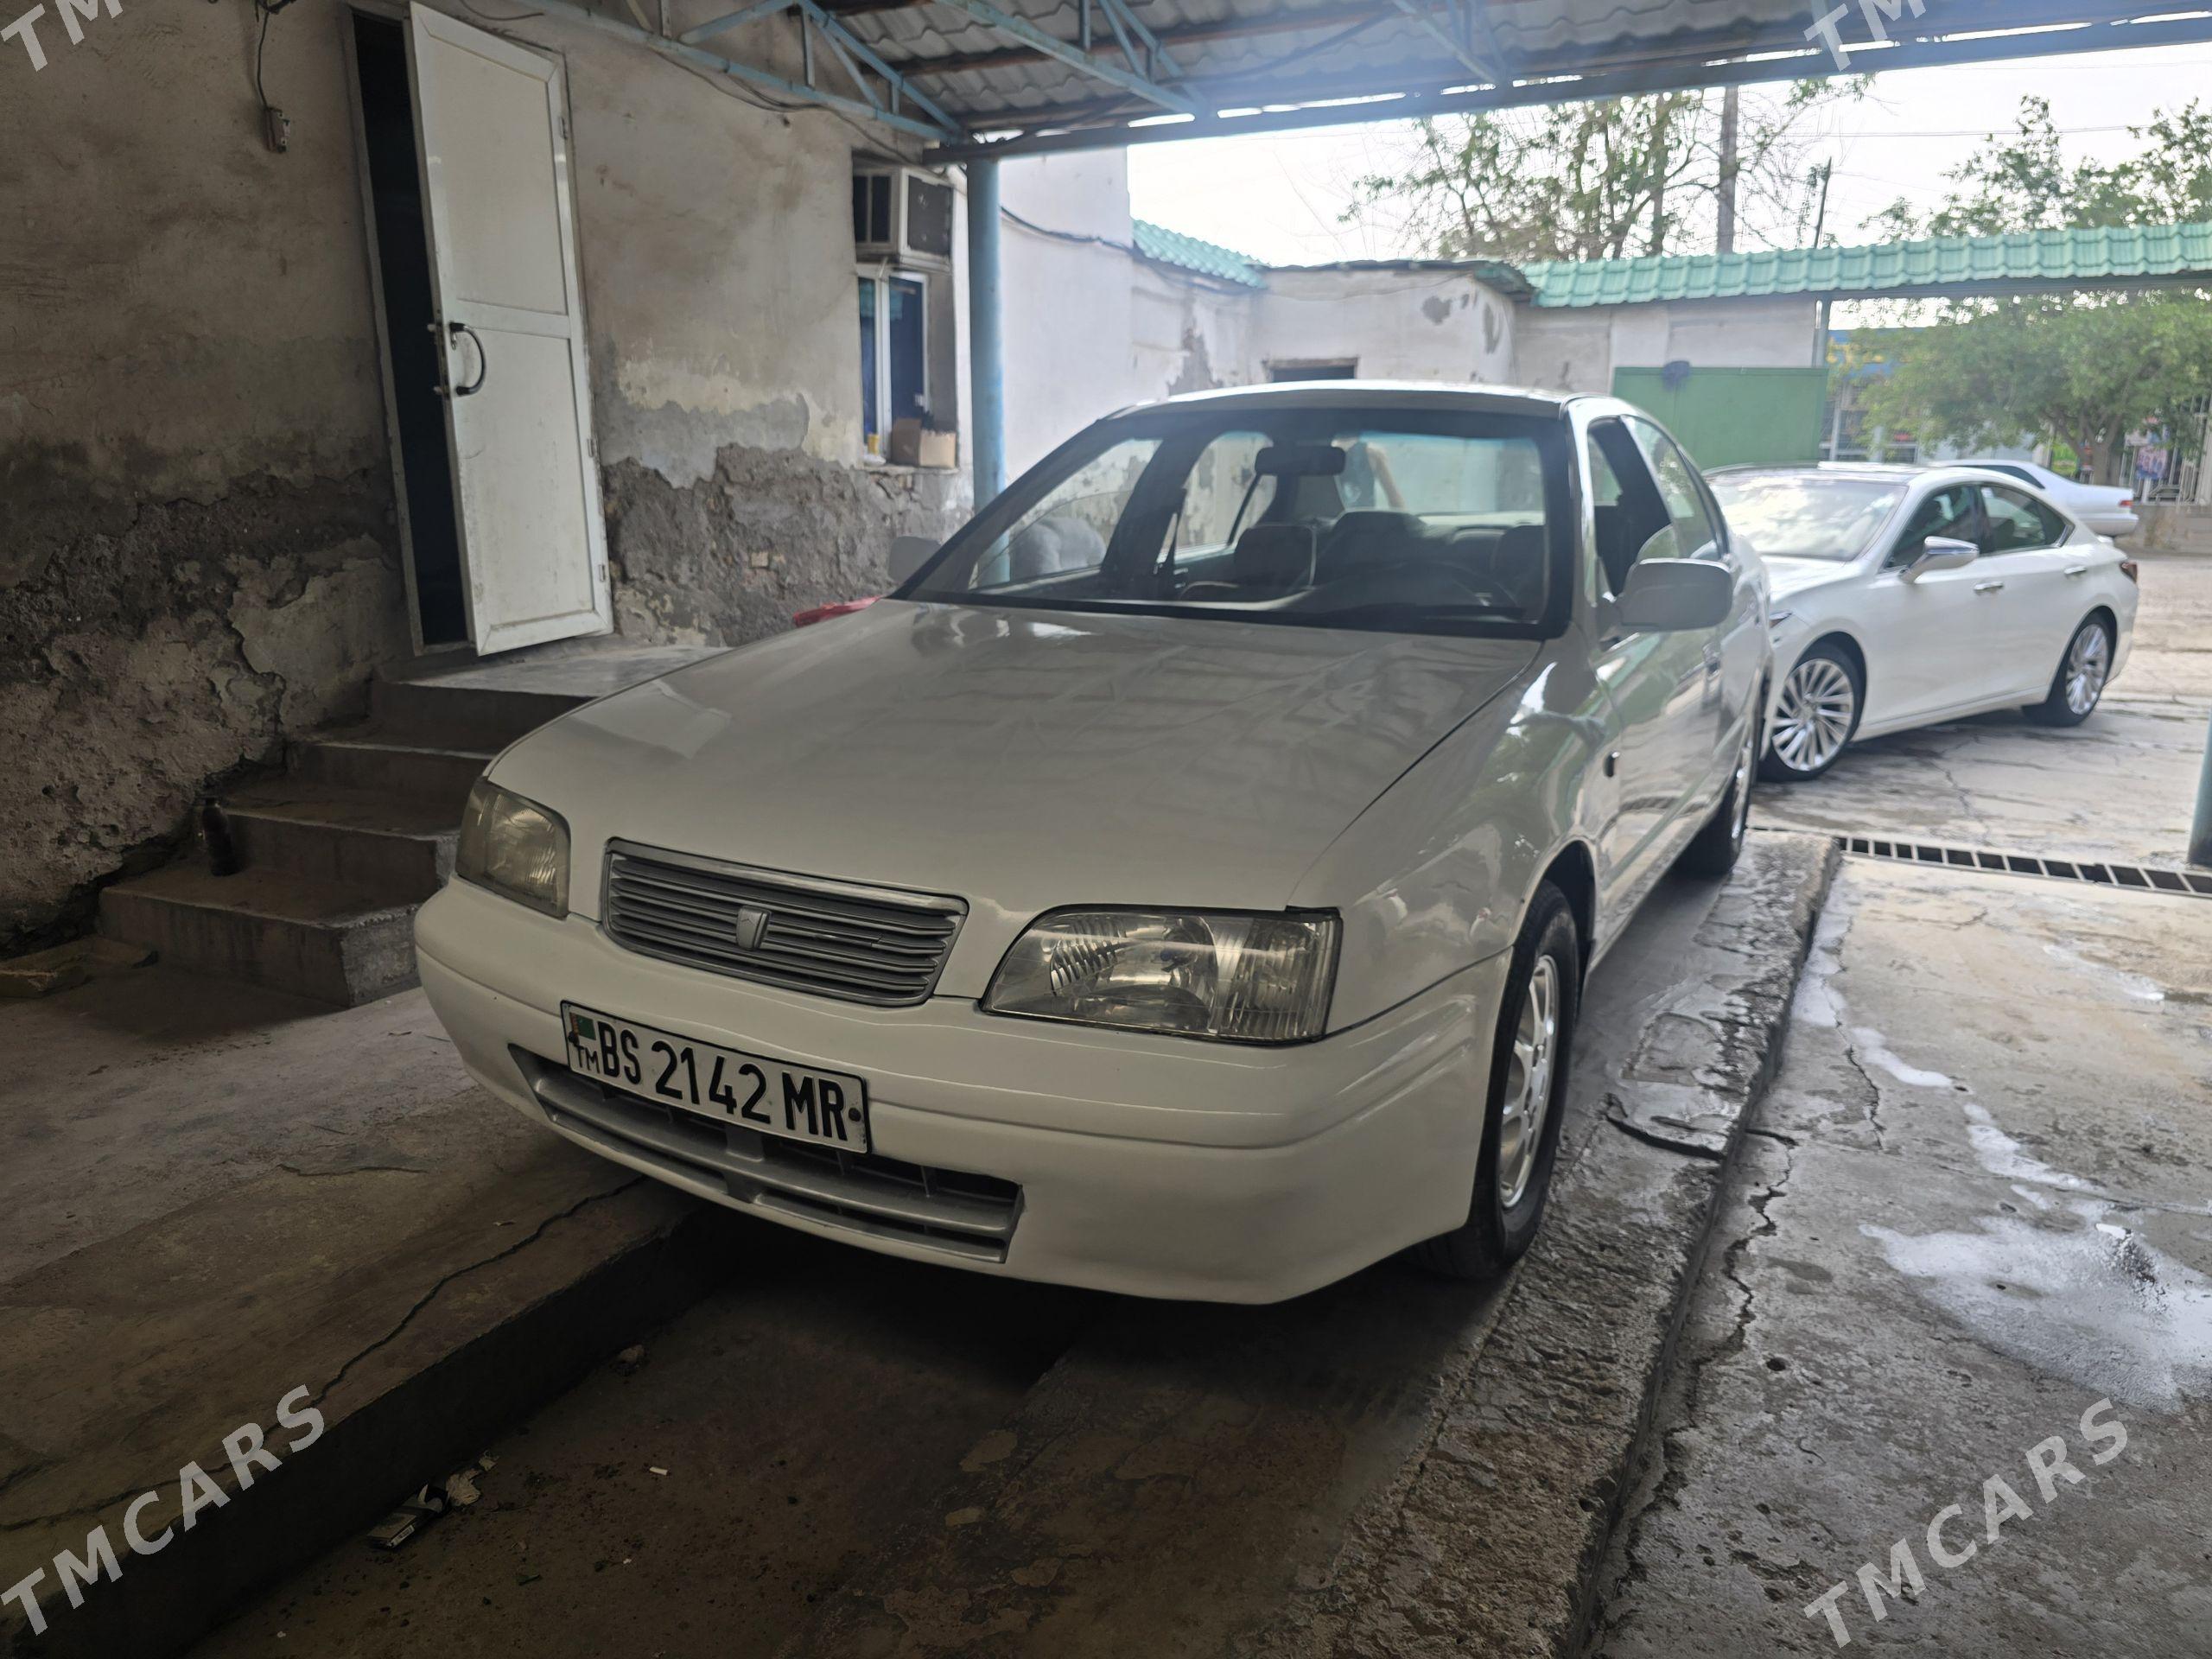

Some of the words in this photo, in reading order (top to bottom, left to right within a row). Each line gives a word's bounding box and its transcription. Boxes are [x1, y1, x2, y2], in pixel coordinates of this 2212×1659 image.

[574, 1042, 601, 1074] TM
[597, 1020, 642, 1084] BS
[651, 1040, 771, 1124] 2142
[781, 1071, 848, 1141] MR
